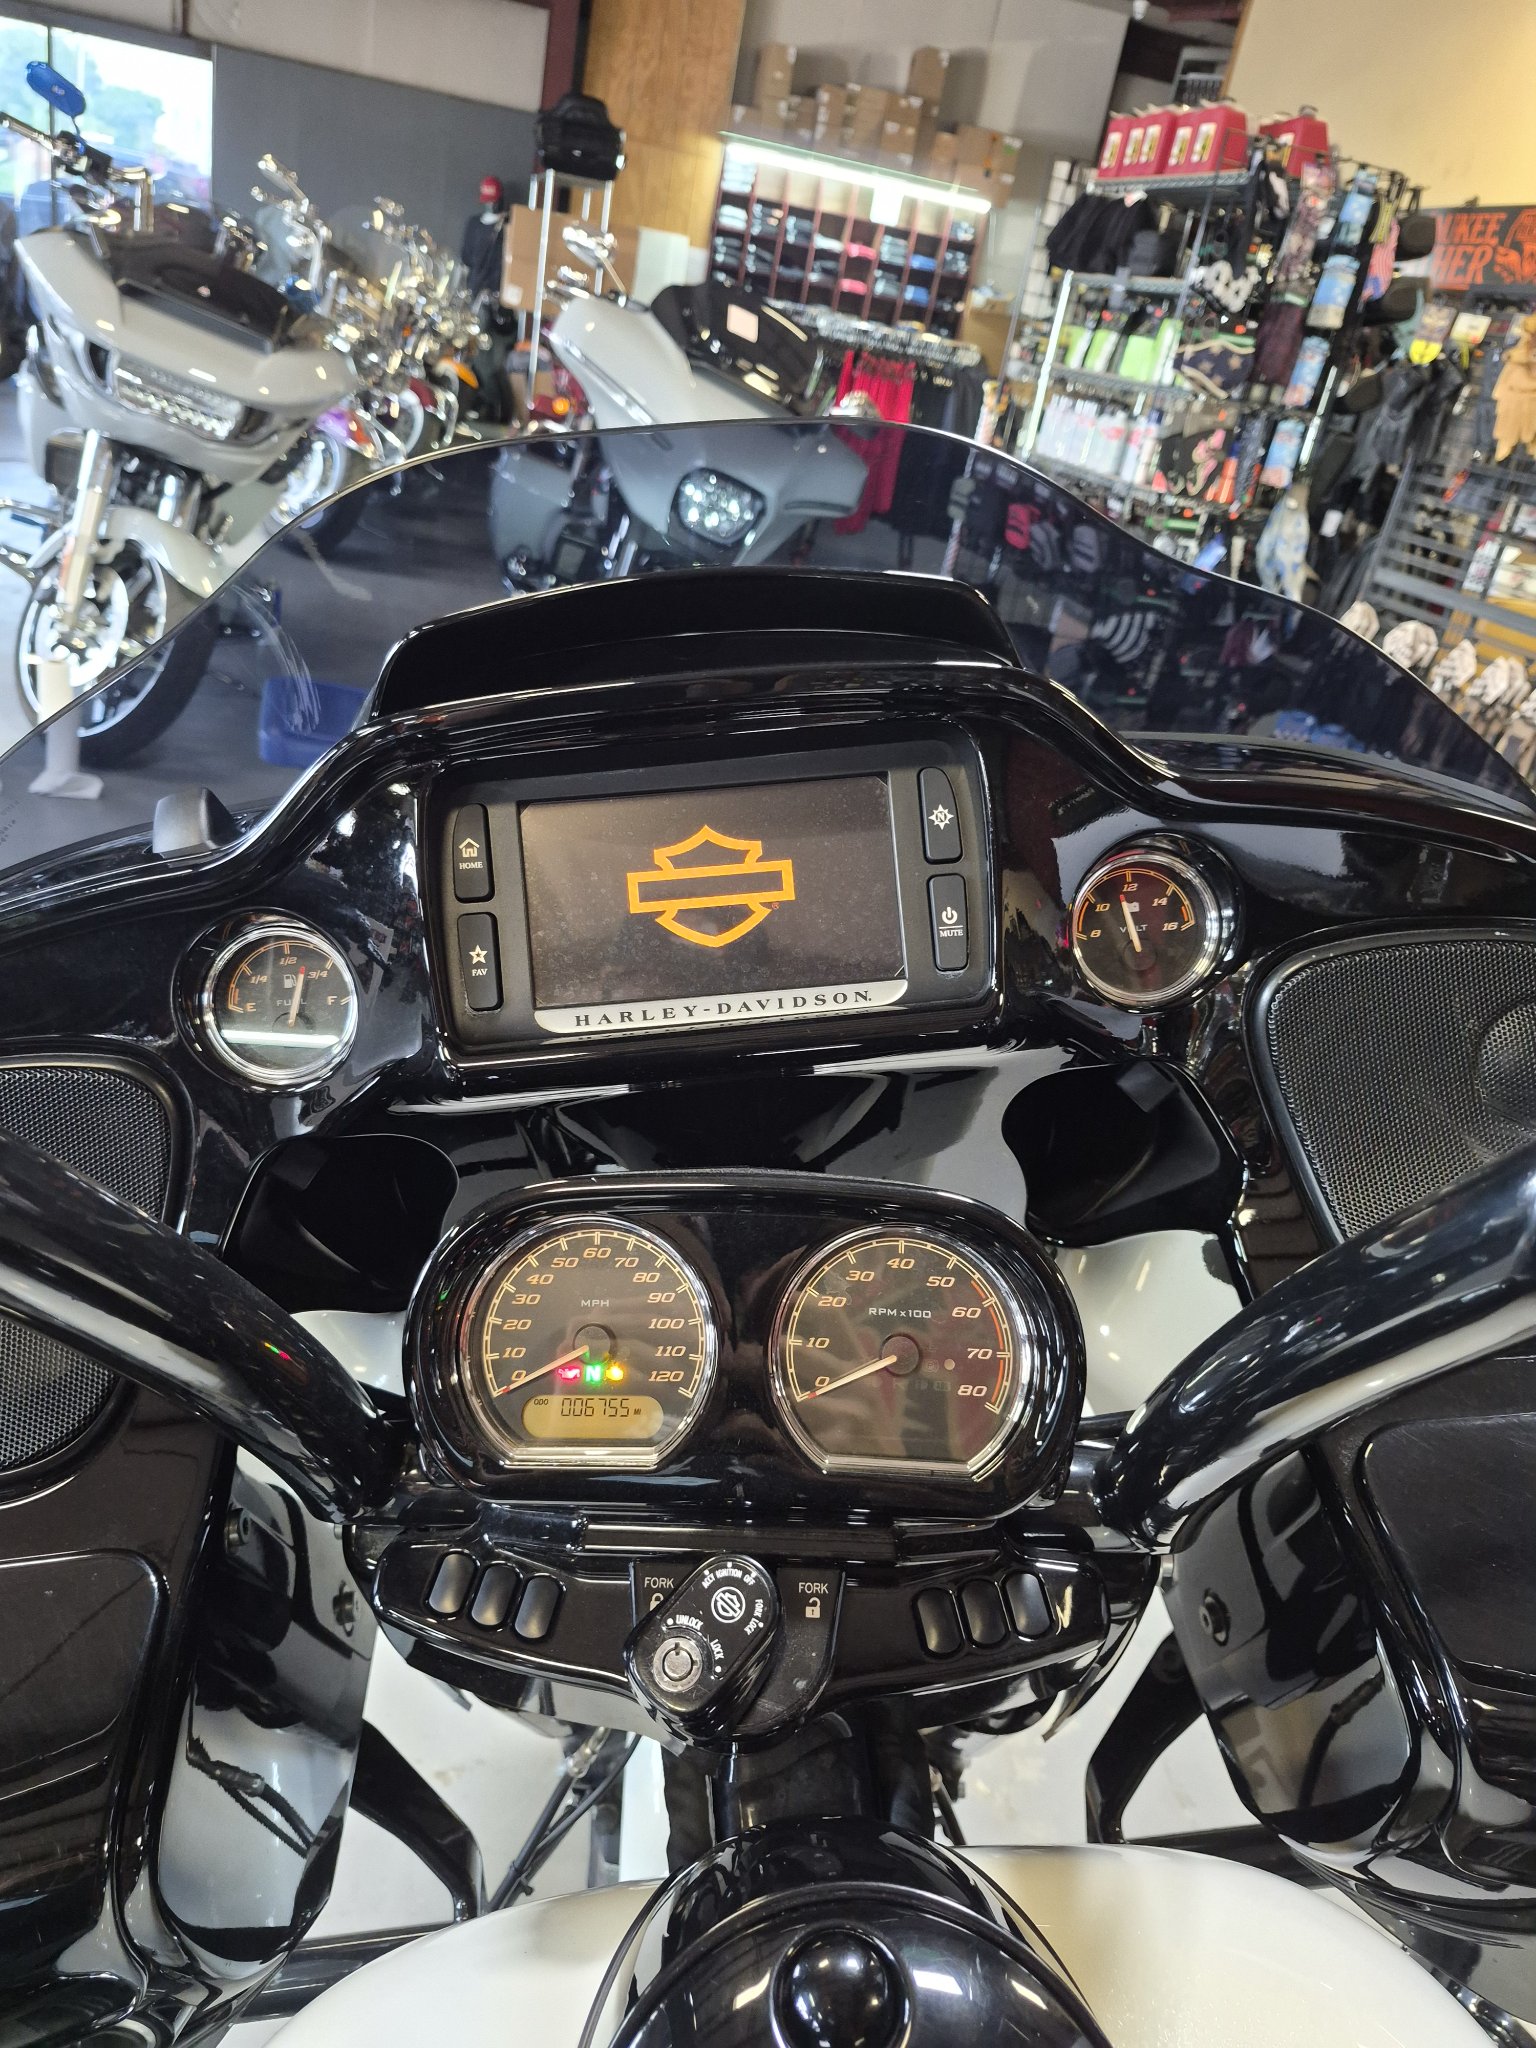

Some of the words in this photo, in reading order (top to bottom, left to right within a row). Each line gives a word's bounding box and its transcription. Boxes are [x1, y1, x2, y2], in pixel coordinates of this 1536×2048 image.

[459, 861, 484, 870] HOME
[1122, 883, 1139, 892] 12
[1094, 903, 1111, 912] 10
[1151, 897, 1168, 907] 14
[1119, 924, 1149, 934] VLT
[1162, 922, 1179, 931] 16
[939, 929, 964, 938] MUTE
[1090, 929, 1102, 938] 8
[279, 956, 298, 966] 1/2
[307, 970, 329, 980] 3/4
[471, 968, 489, 977] FAV
[250, 975, 269, 985] 1/4
[276, 998, 308, 1007] FUL
[327, 995, 338, 1006] F
[246, 1002, 257, 1012] E
[582, 1247, 612, 1260] 60
[550, 1257, 580, 1269] 50
[614, 1257, 640, 1269] 70
[886, 1257, 916, 1270] 40
[525, 1274, 555, 1285] 40
[632, 1272, 661, 1284] 80
[845, 1270, 875, 1283] 30
[925, 1276, 956, 1288] 50
[511, 1293, 541, 1305] 30
[580, 1299, 610, 1308] MPH
[647, 1292, 676, 1304] 90
[817, 1296, 848, 1308] 20
[868, 1307, 898, 1317] RPM
[899, 1308, 932, 1319] x100
[951, 1306, 982, 1319] 60
[502, 1319, 532, 1331] 20
[648, 1318, 685, 1330] 100
[805, 1337, 831, 1349] 10
[502, 1347, 527, 1359] 10
[654, 1345, 687, 1357] 110
[966, 1348, 993, 1360] 70
[510, 1369, 527, 1382] 0
[585, 1366, 602, 1382] N
[648, 1370, 685, 1382] 120
[814, 1376, 831, 1388] 0
[957, 1385, 988, 1397] 80
[533, 1398, 549, 1406] ODO
[560, 1397, 631, 1418] 006755
[644, 1577, 675, 1589] FORK
[715, 1568, 743, 1579] IGNITION
[743, 1573, 756, 1586] OFF
[798, 1582, 829, 1594] FORK
[753, 1598, 764, 1618] FORK
[675, 1614, 704, 1631] UNLOCK
[743, 1617, 761, 1636] LOCK
[709, 1638, 725, 1661] LOCK
